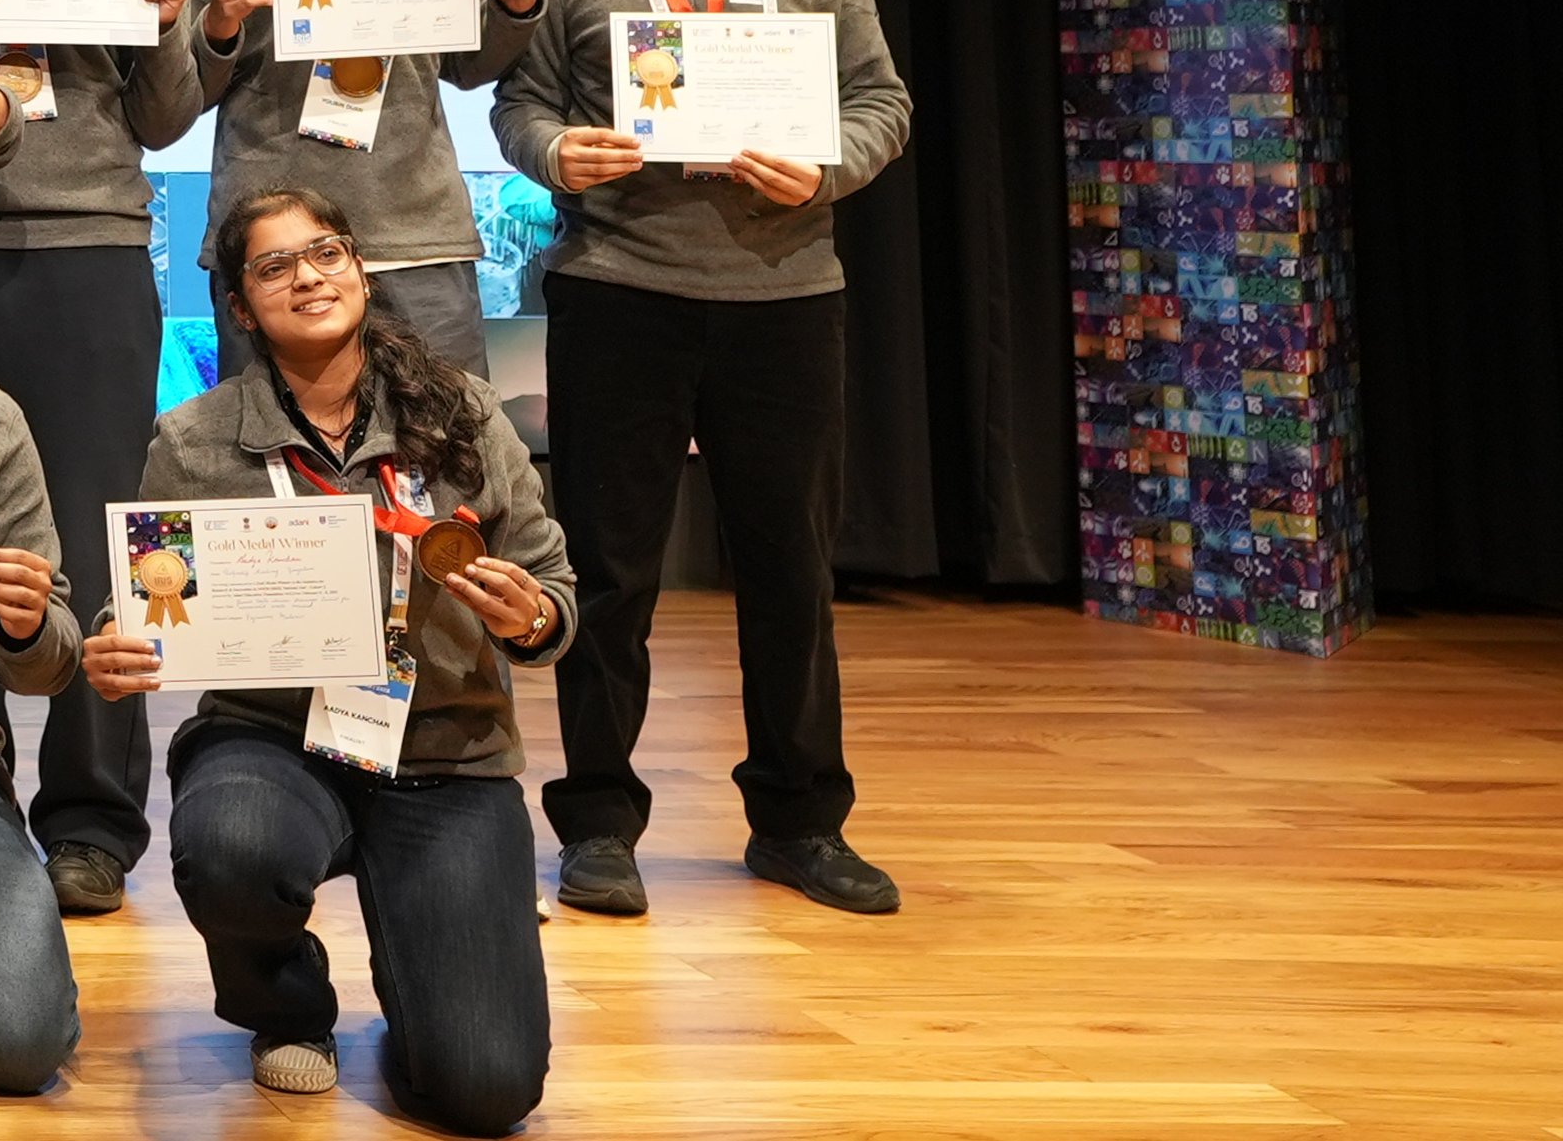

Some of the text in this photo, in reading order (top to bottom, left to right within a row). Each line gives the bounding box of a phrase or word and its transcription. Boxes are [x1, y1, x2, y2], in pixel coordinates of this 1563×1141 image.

[207, 537, 326, 552] Gold Medal Winner
[323, 704, 391, 729] AADYA KANCHAN
